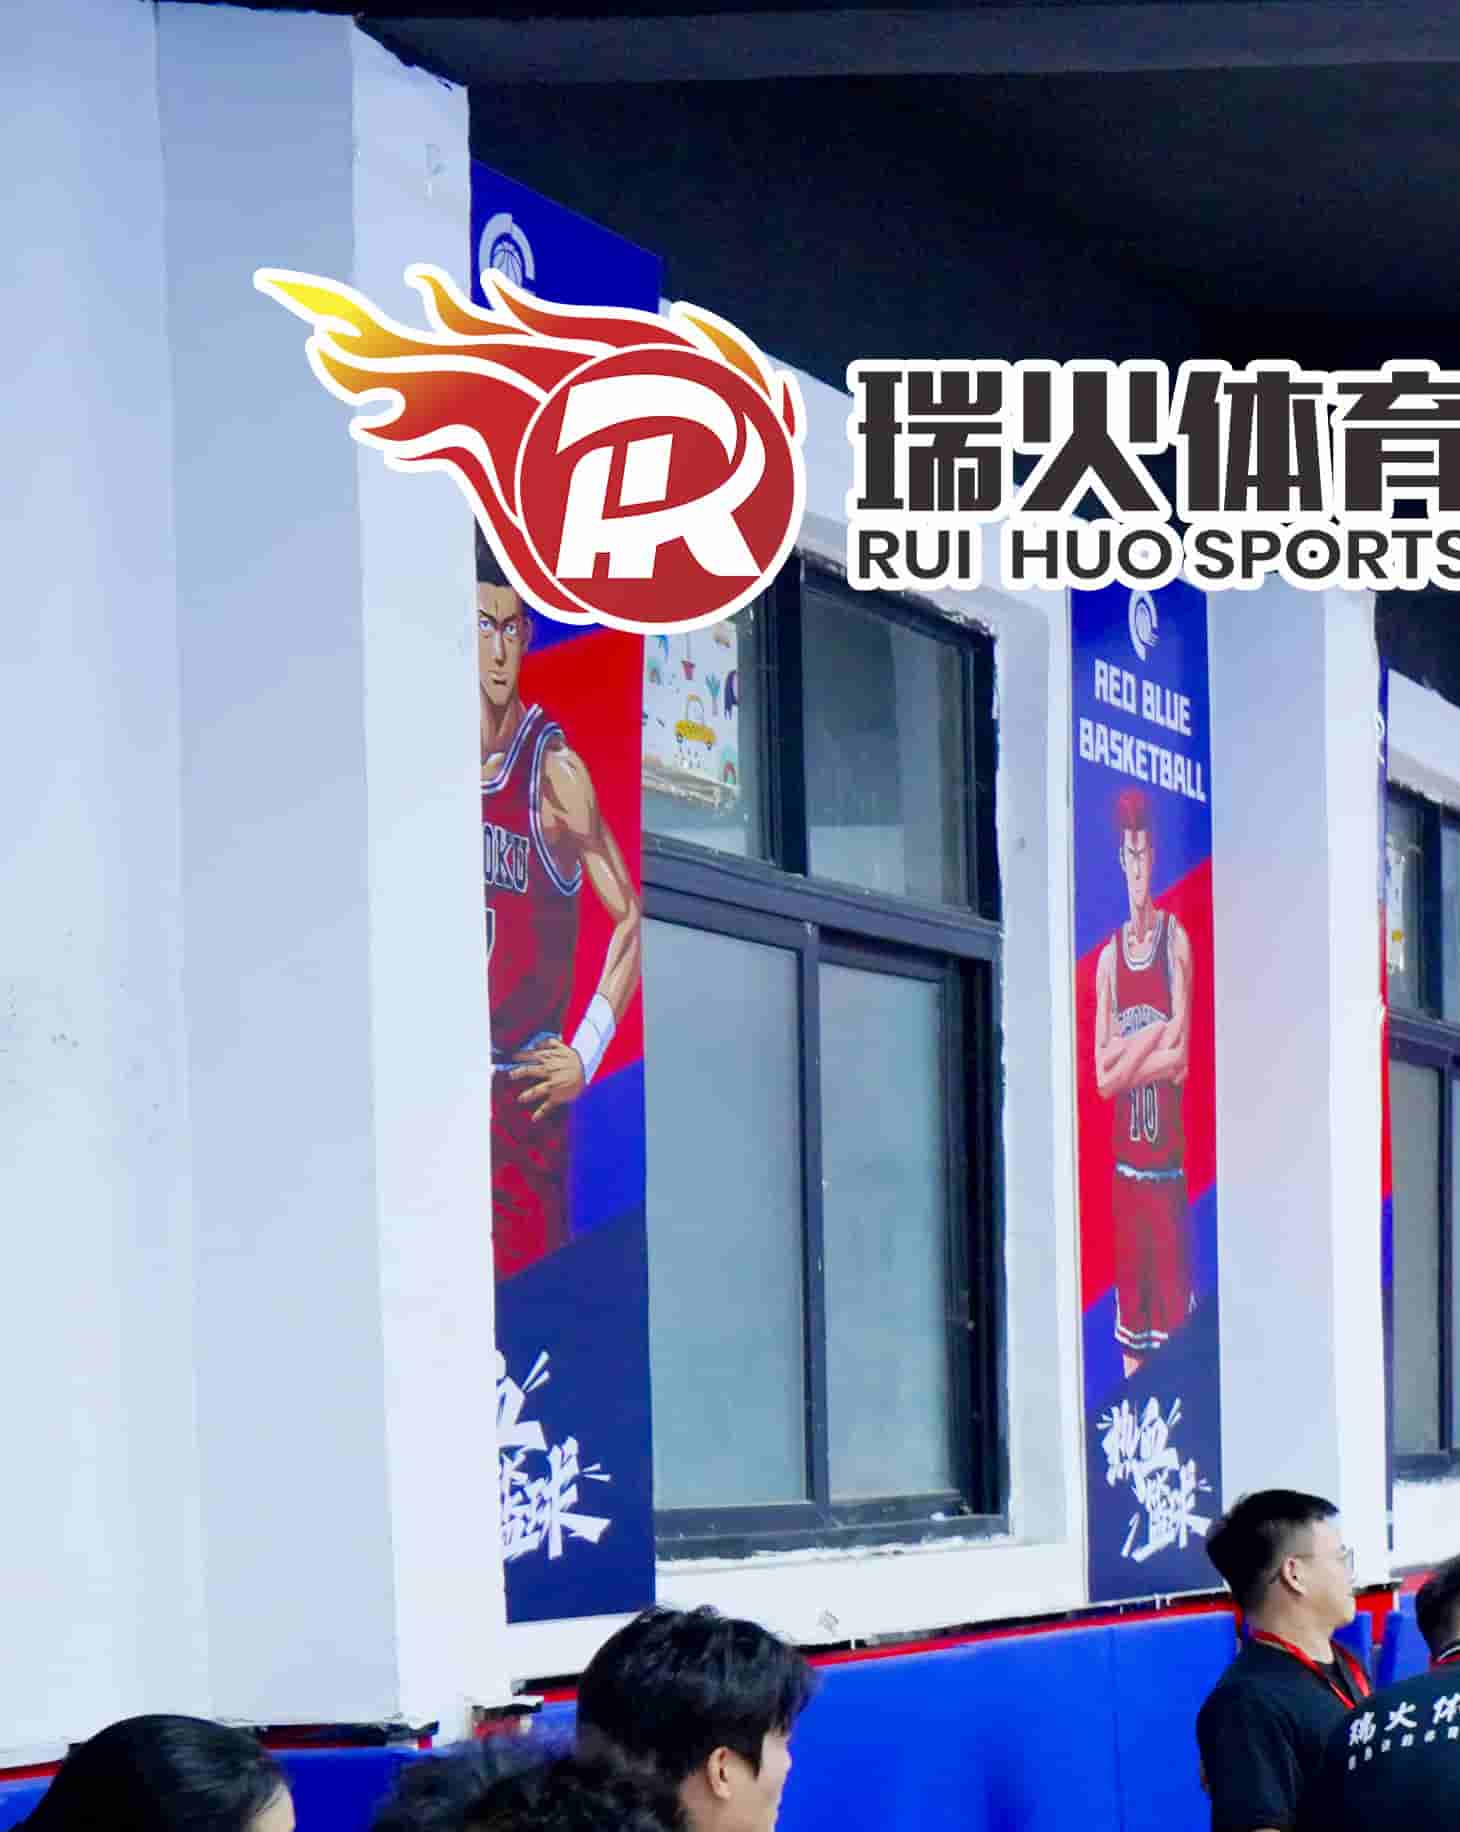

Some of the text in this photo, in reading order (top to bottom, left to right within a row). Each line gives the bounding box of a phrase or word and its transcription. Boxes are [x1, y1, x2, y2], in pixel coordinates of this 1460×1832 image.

[1094, 659, 1192, 738] RED BLUE
[1079, 717, 1207, 803] BASKETBALL
